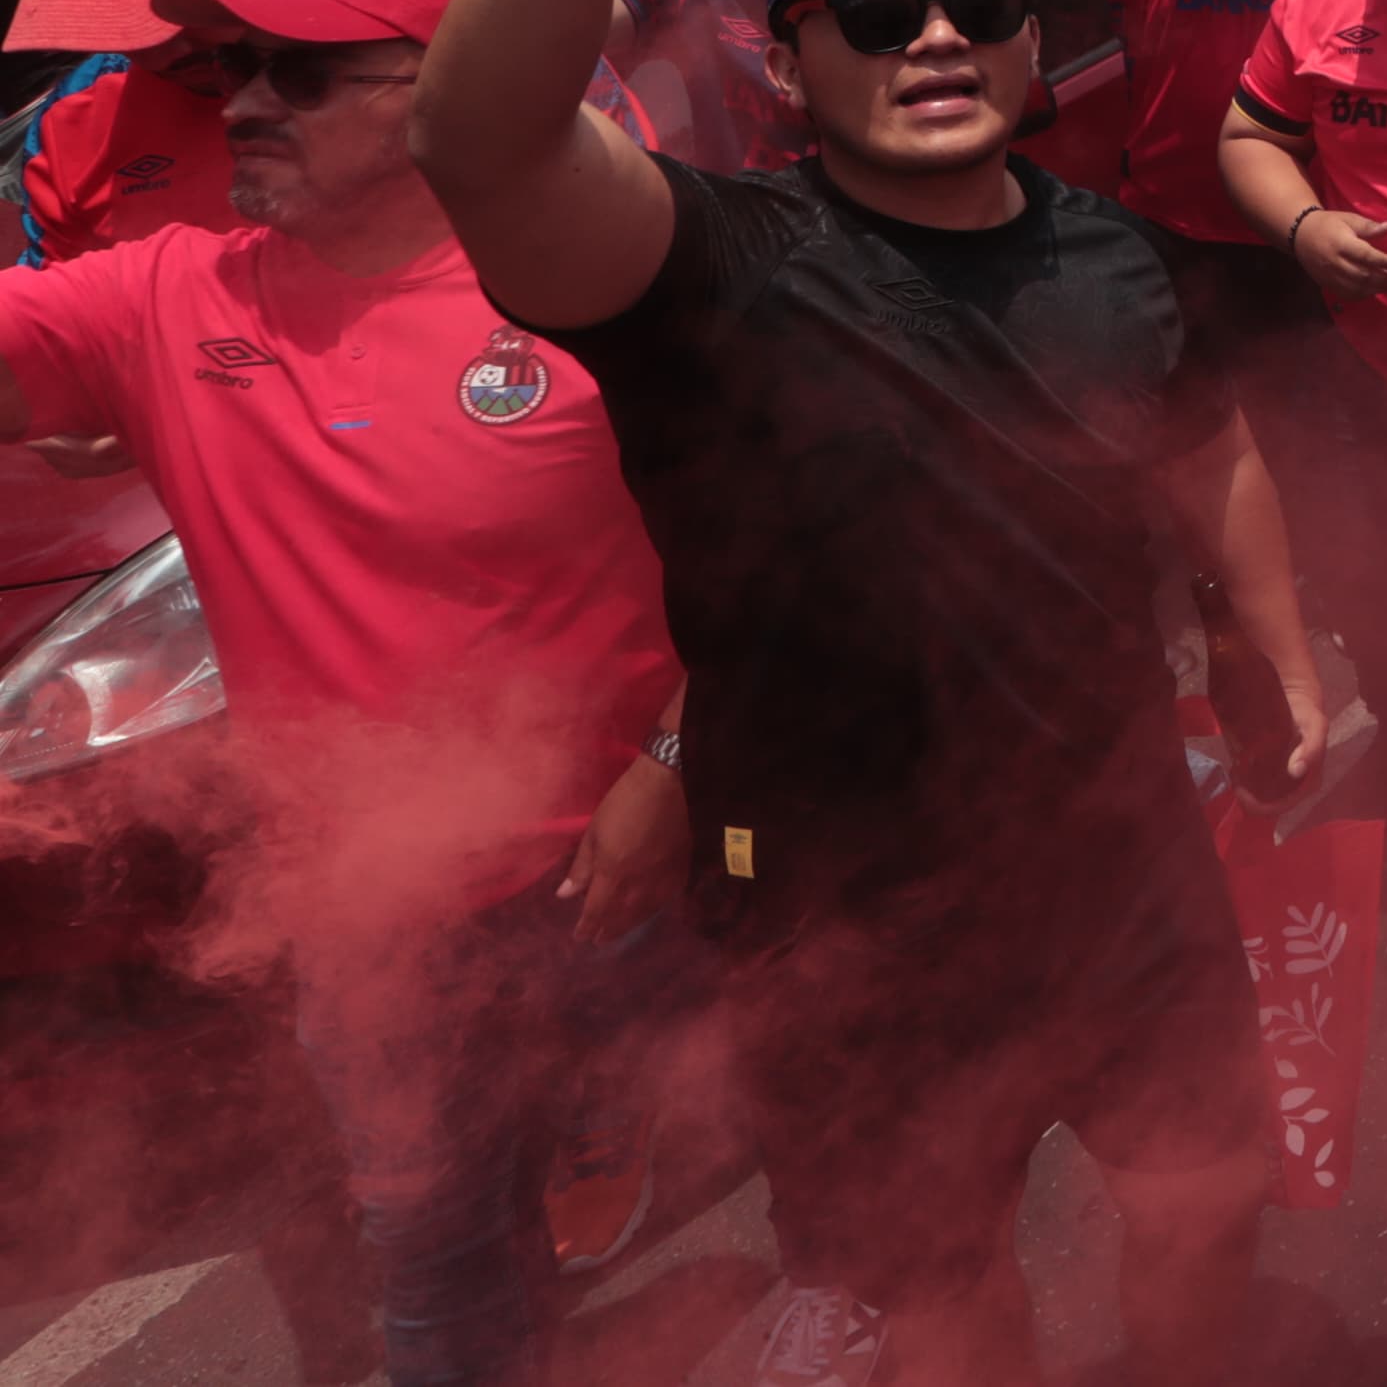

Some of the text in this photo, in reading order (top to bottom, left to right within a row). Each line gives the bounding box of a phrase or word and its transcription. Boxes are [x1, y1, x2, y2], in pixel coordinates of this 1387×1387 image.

[718, 32, 761, 53] umbro
[1338, 47, 1375, 55] umbro
[121, 179, 171, 195] umbro
[194, 368, 253, 390] umbro
